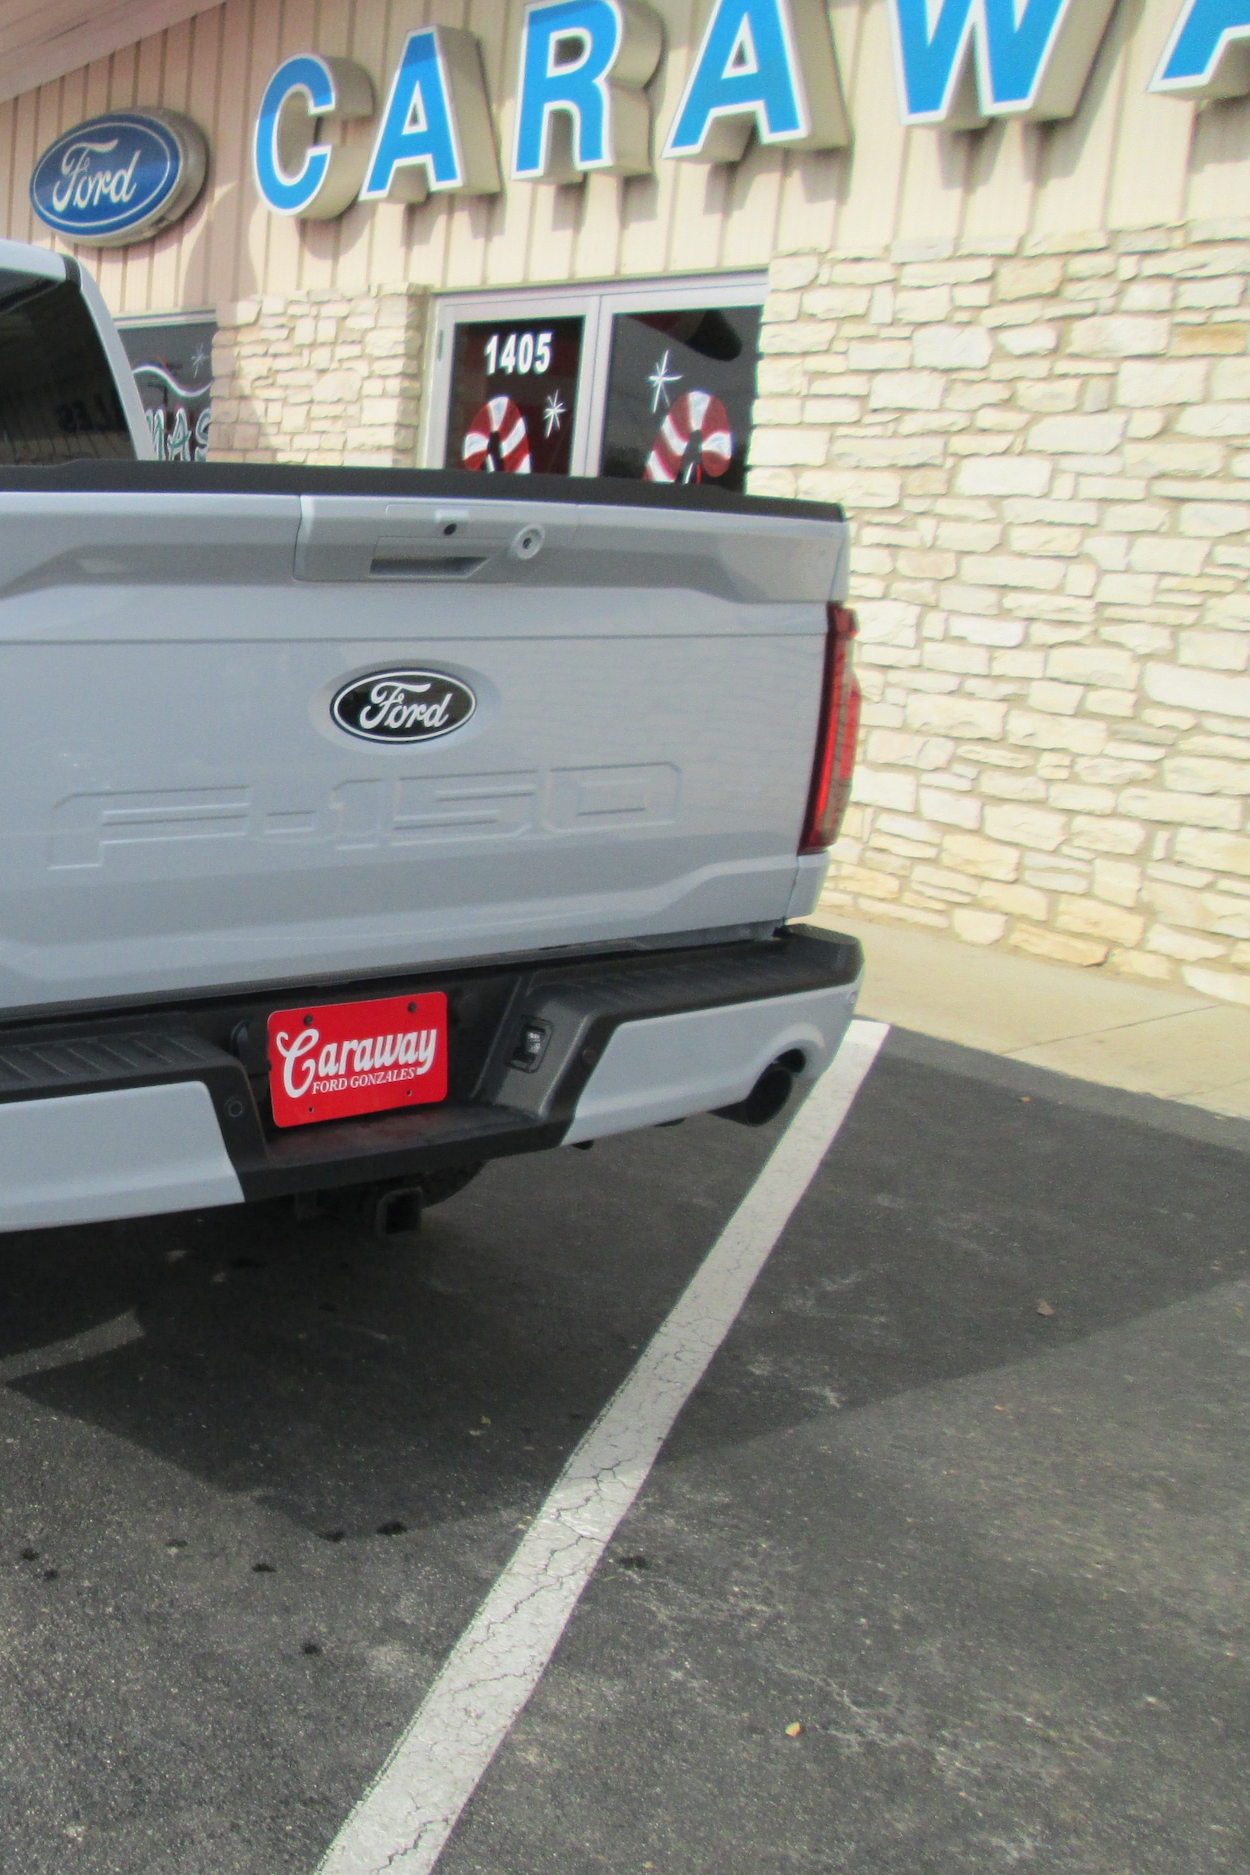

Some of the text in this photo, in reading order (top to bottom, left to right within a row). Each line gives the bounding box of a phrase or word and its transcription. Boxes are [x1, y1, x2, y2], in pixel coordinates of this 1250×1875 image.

[53, 139, 141, 212] Ford
[485, 331, 552, 376] 1405
[360, 681, 453, 730] Ford
[276, 1028, 437, 1098] Caraway
[312, 1067, 416, 1094] FORD GONZALES
